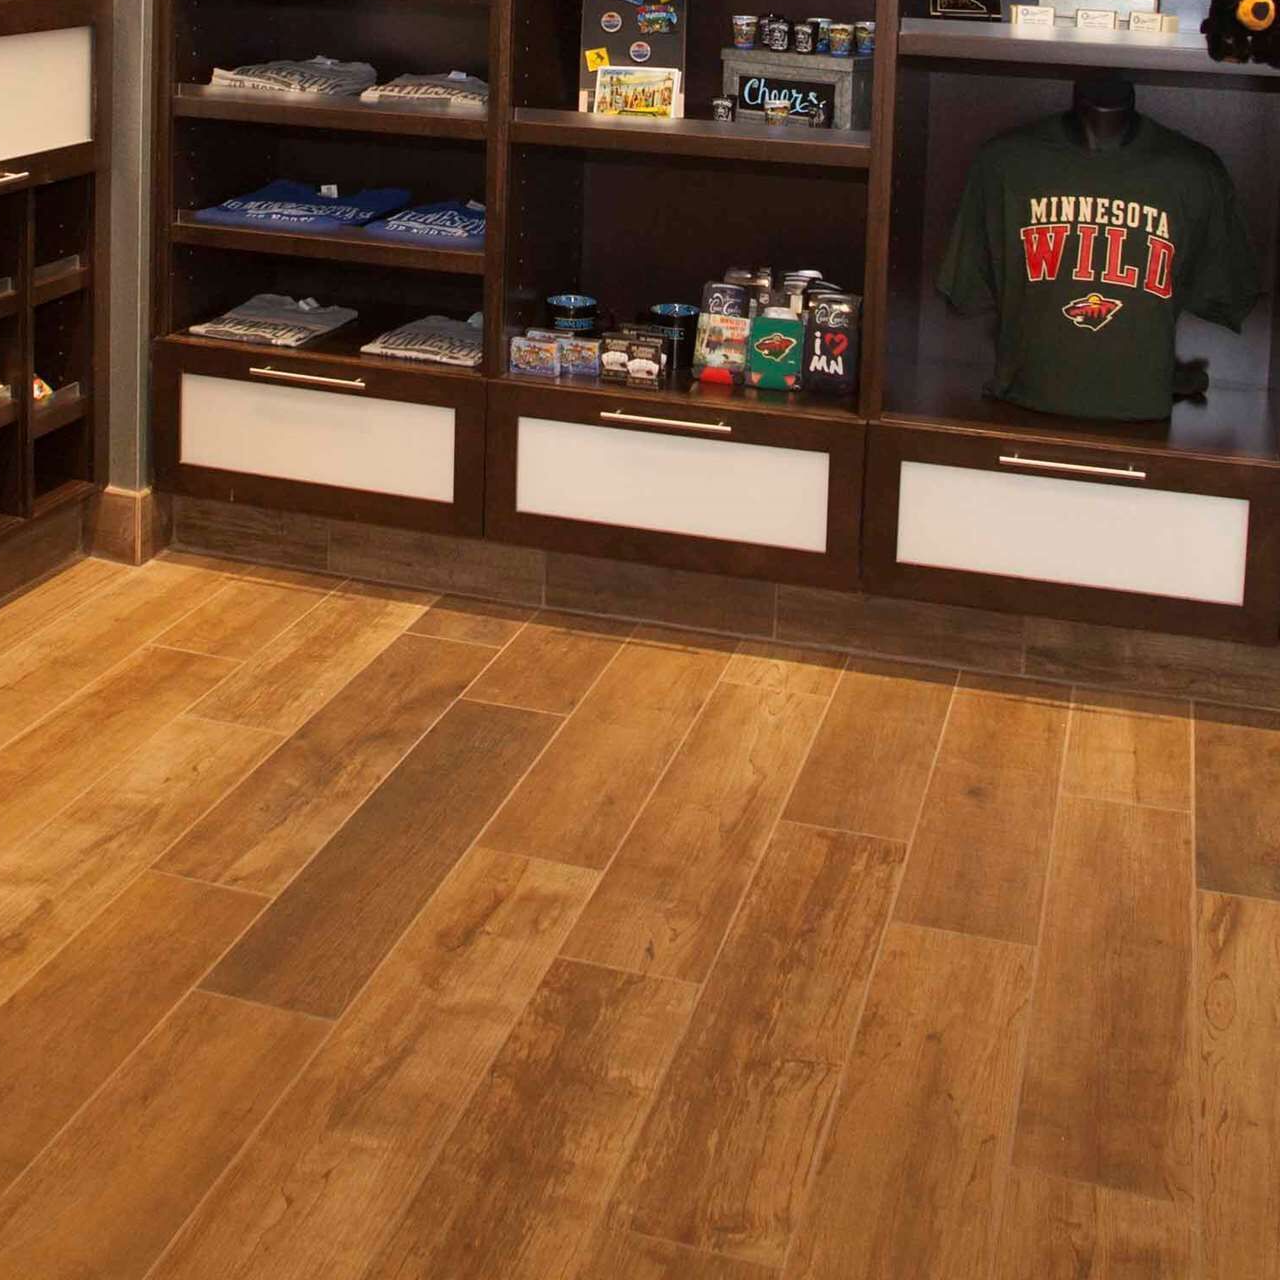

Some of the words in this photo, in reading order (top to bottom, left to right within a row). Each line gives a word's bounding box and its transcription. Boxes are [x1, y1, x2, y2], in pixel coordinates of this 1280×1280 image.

[1030, 196, 1170, 239] MINNESOTA
[1020, 224, 1176, 299] WILD
[809, 355, 844, 376] MN
